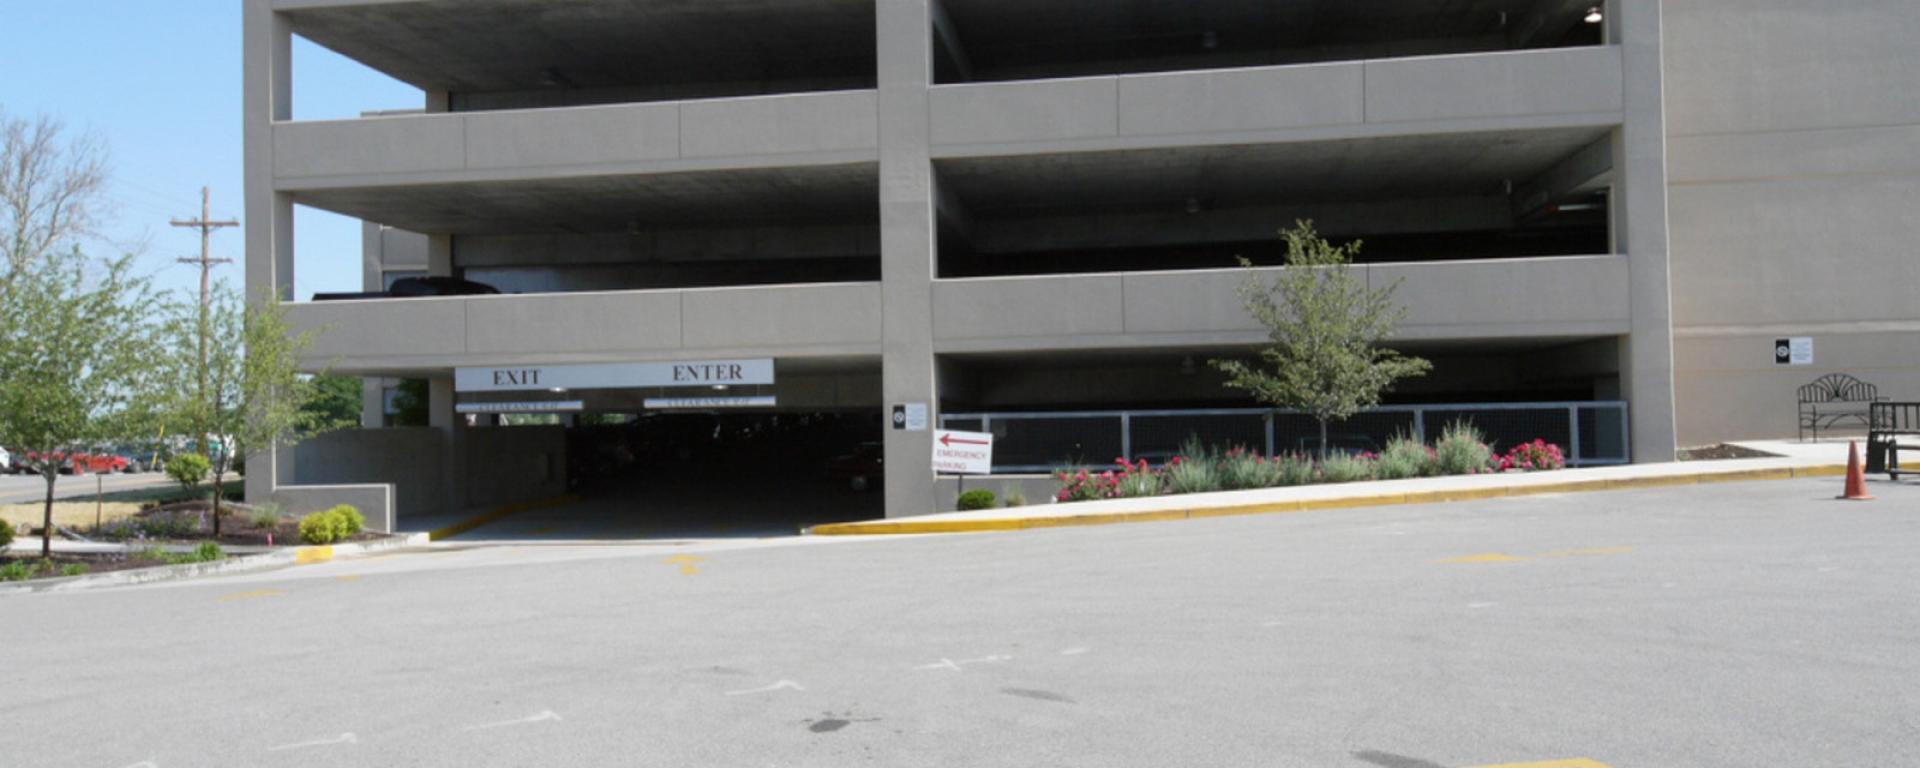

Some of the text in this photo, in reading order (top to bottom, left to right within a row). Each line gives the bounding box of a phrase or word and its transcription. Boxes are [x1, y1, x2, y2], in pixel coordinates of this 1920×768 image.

[492, 369, 542, 385] EXIT
[672, 364, 743, 381] ENTER
[937, 449, 986, 460] EMERGENCY
[933, 460, 968, 470] PARKING
